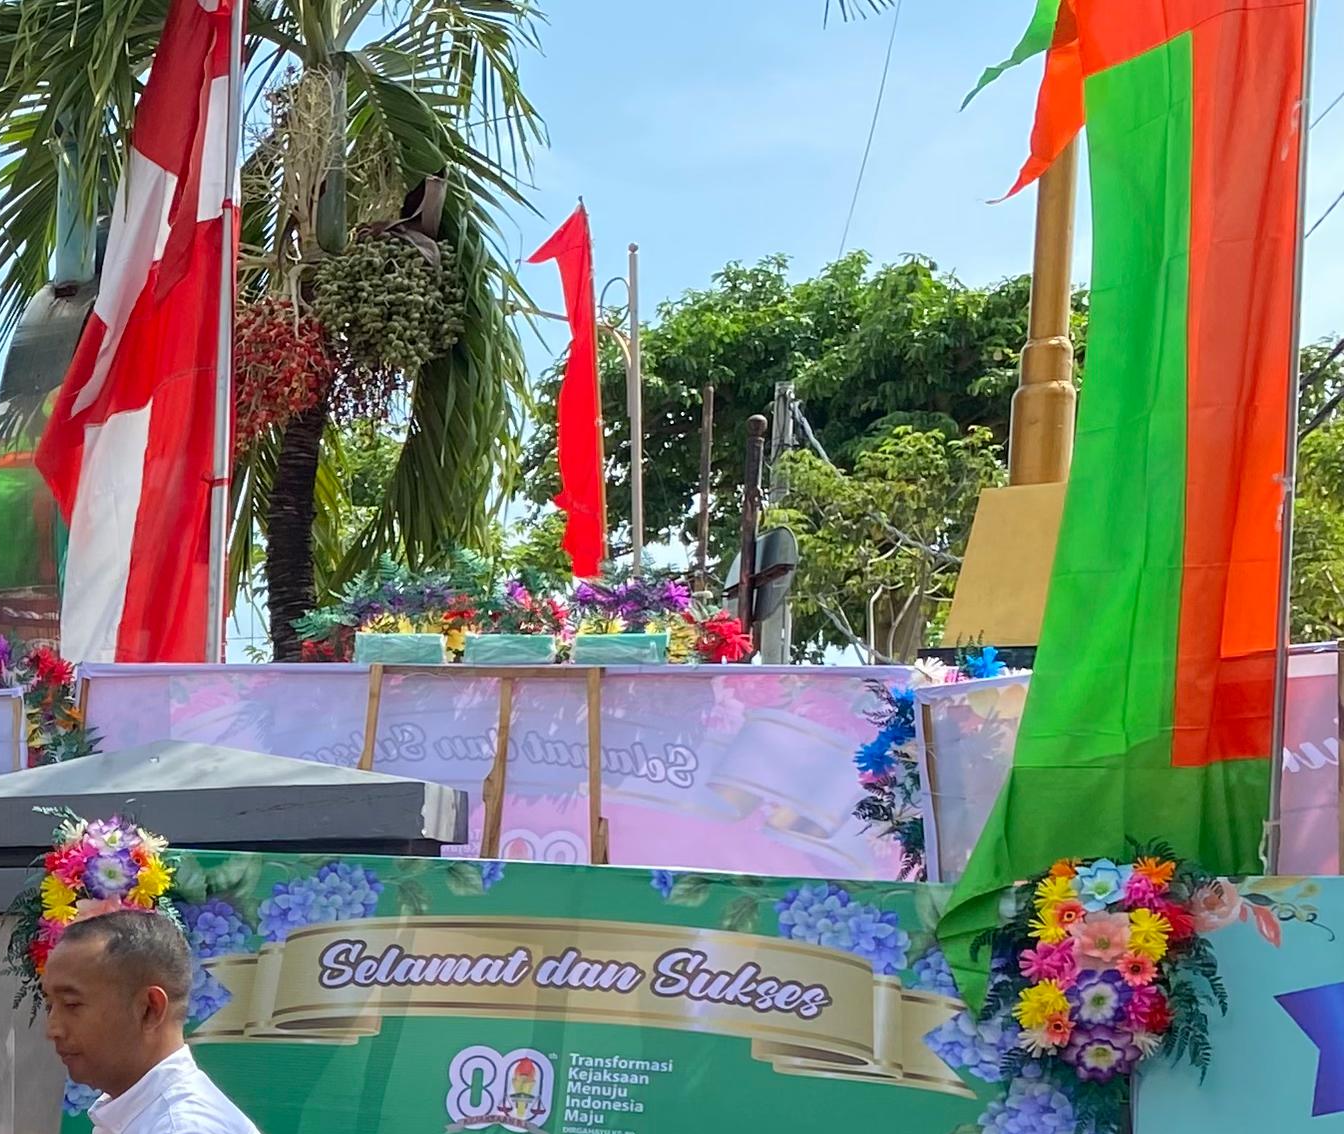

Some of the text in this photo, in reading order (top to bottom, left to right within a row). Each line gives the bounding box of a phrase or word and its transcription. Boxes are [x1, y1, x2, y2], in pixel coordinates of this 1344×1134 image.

[318, 938, 834, 1020] Selamat dan Sukses
[568, 1052, 674, 1073] Transformasi
[567, 1067, 650, 1086] Kejaksaan
[566, 1081, 628, 1099] Menuju
[565, 1095, 645, 1114] Indonesia
[564, 1108, 605, 1127] Maju
